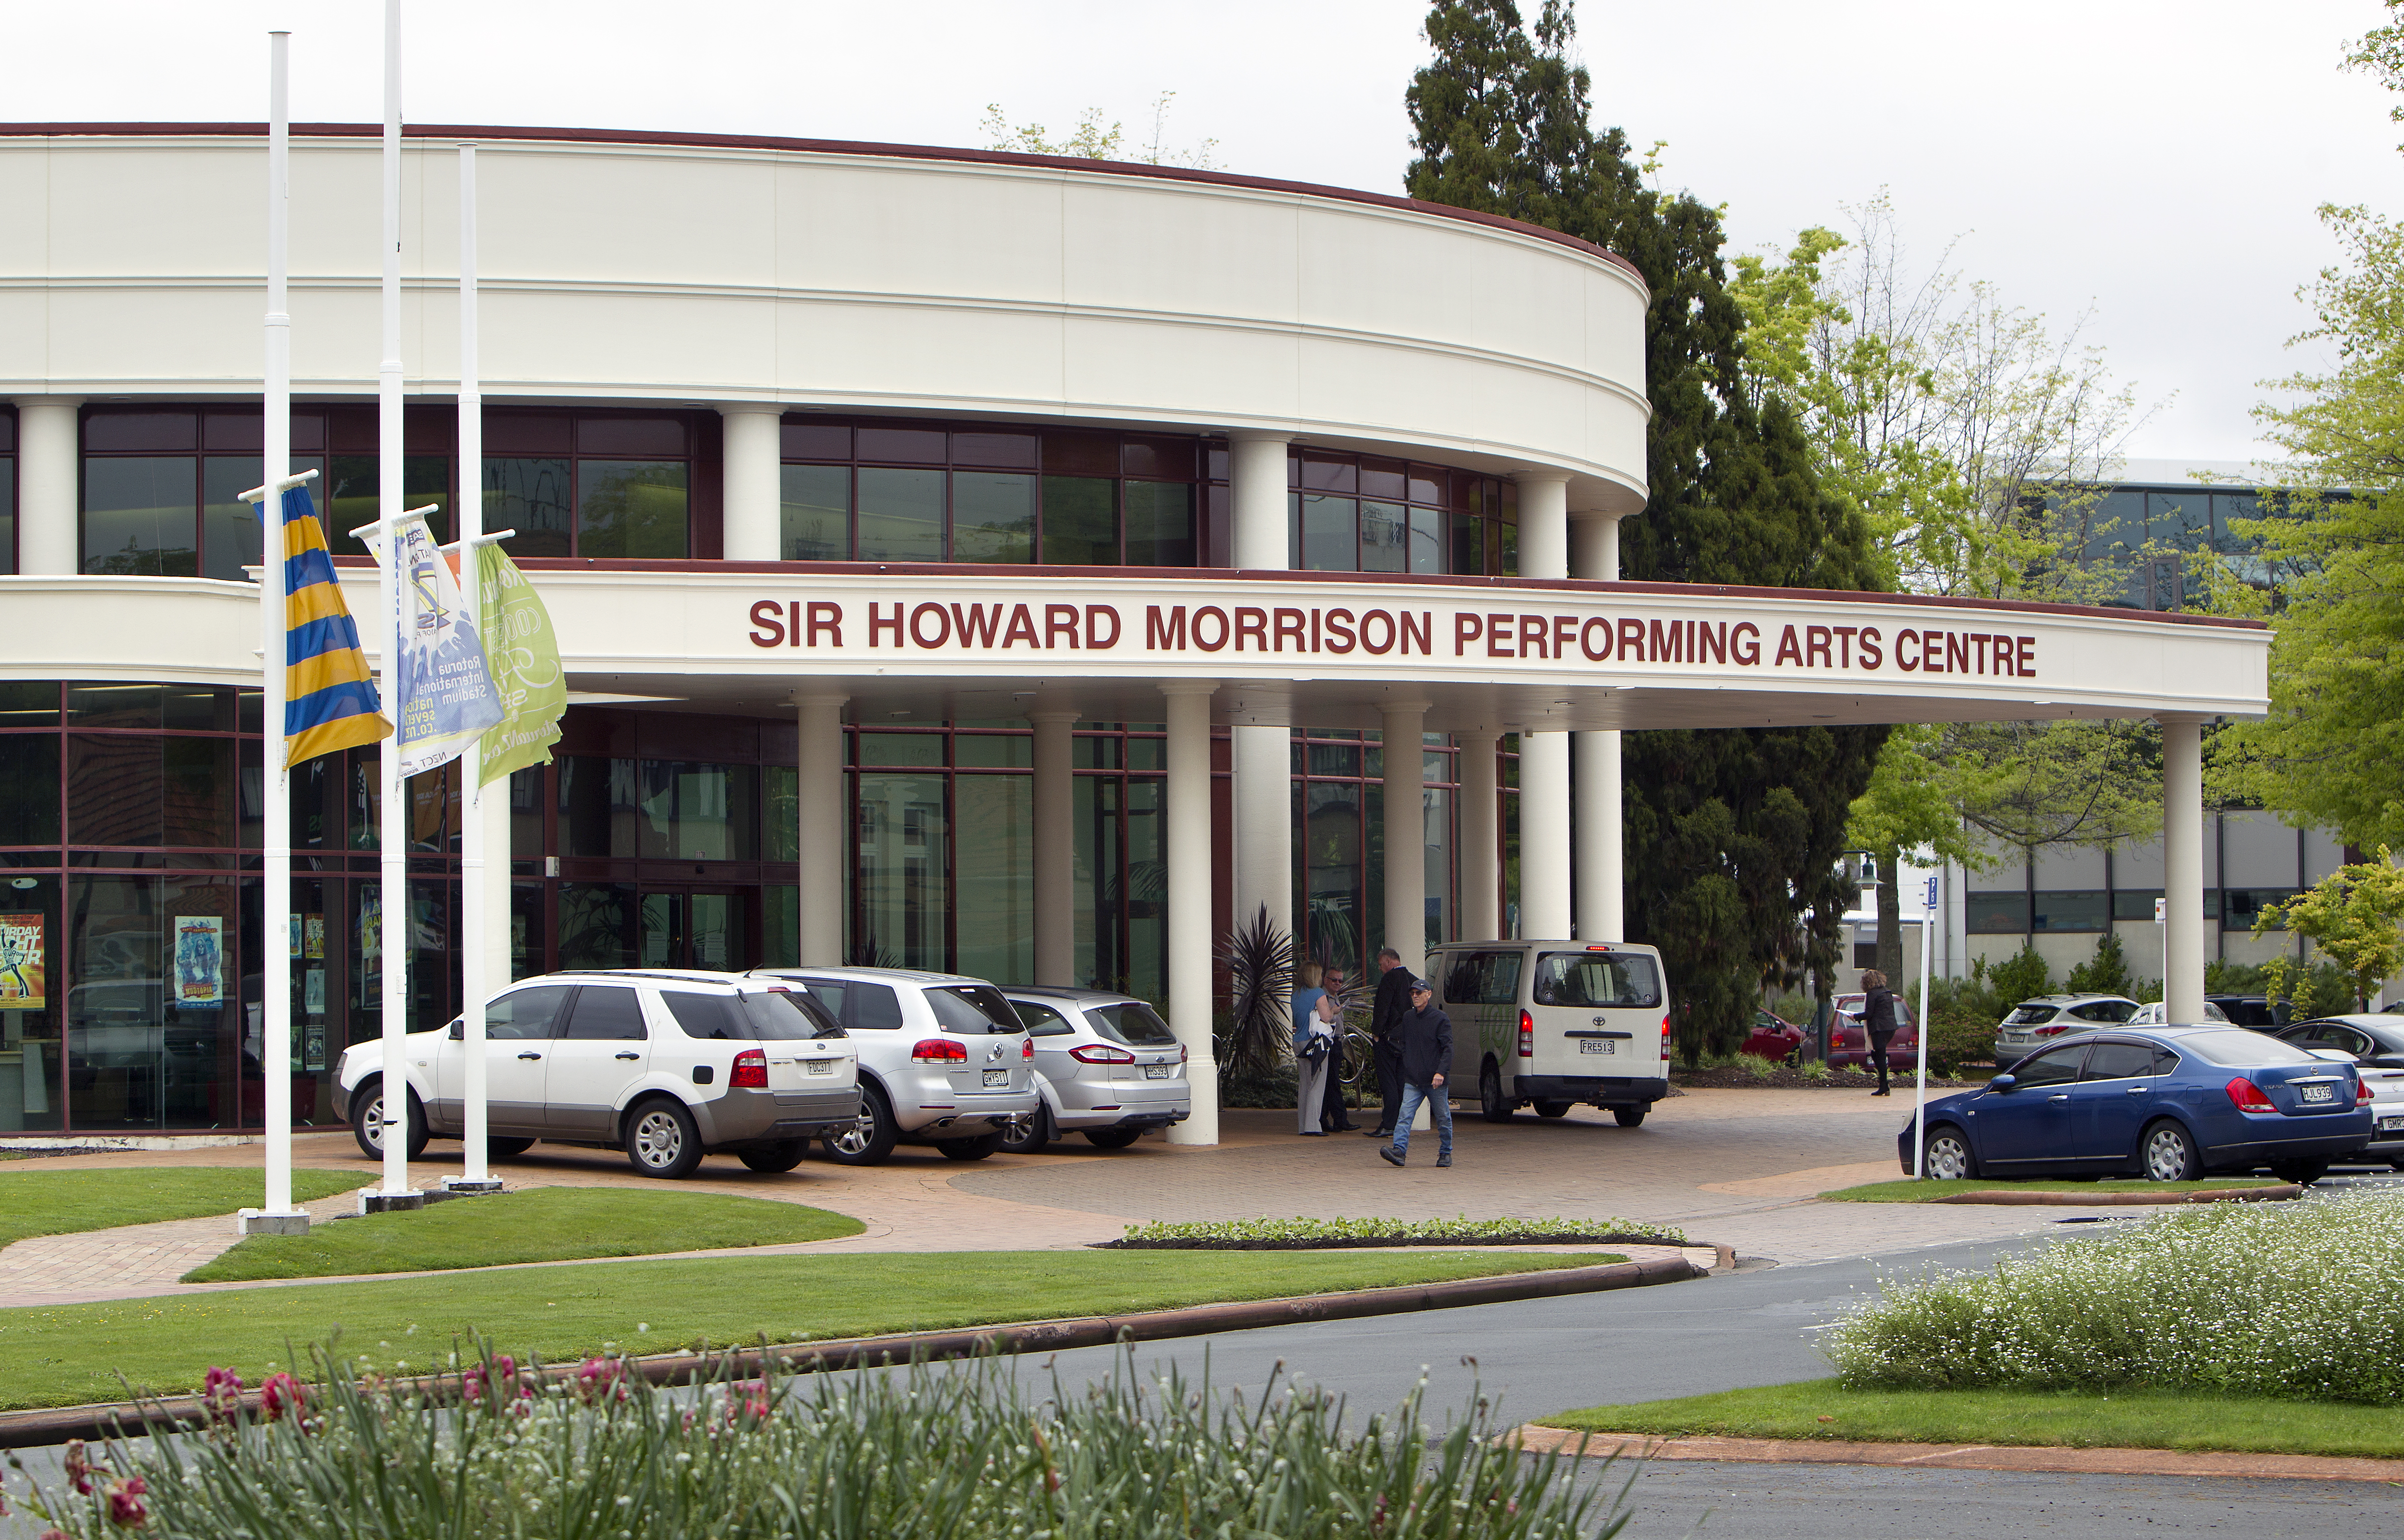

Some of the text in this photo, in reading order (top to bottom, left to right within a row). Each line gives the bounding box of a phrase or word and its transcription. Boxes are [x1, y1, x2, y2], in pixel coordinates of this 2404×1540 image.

[750, 600, 2035, 678] SIR HOWARD MORRISON PERFORMING ARTS CENTRE
[1931, 878, 1935, 891] P
[185, 985, 213, 995] MUDTOPIA
[1582, 1042, 1613, 1052] FRE513
[808, 1061, 831, 1072] FDC377
[1146, 1066, 1167, 1076] HHS393
[983, 1072, 1007, 1083] GWY511
[2303, 1087, 2331, 1099] HJL939
[2387, 1118, 2404, 1129] GMR3
